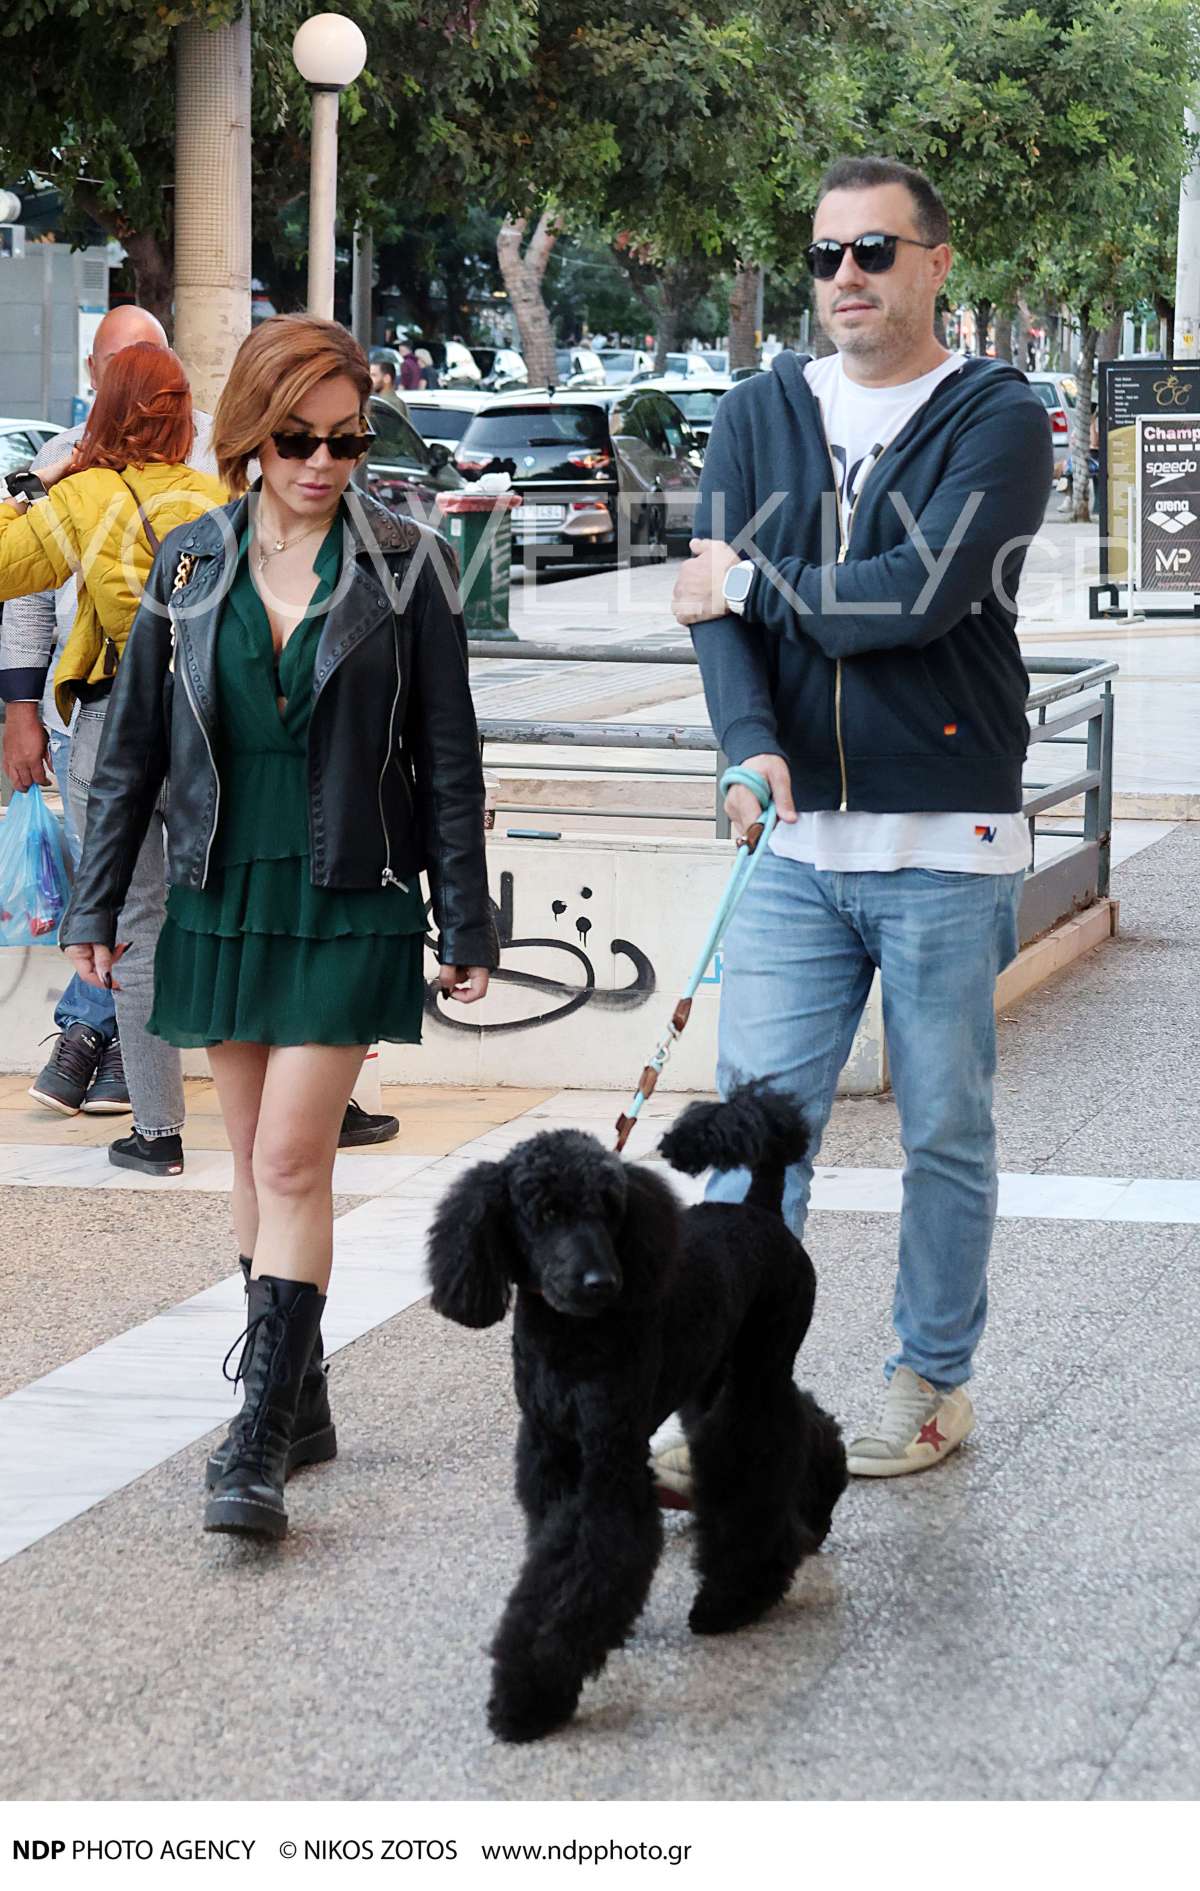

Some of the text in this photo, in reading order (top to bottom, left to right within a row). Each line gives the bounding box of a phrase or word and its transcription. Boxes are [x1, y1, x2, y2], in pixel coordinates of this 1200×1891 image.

[1145, 458, 1197, 476] speedo
[1155, 500, 1189, 512] arena
[1155, 548, 1192, 571] MP
